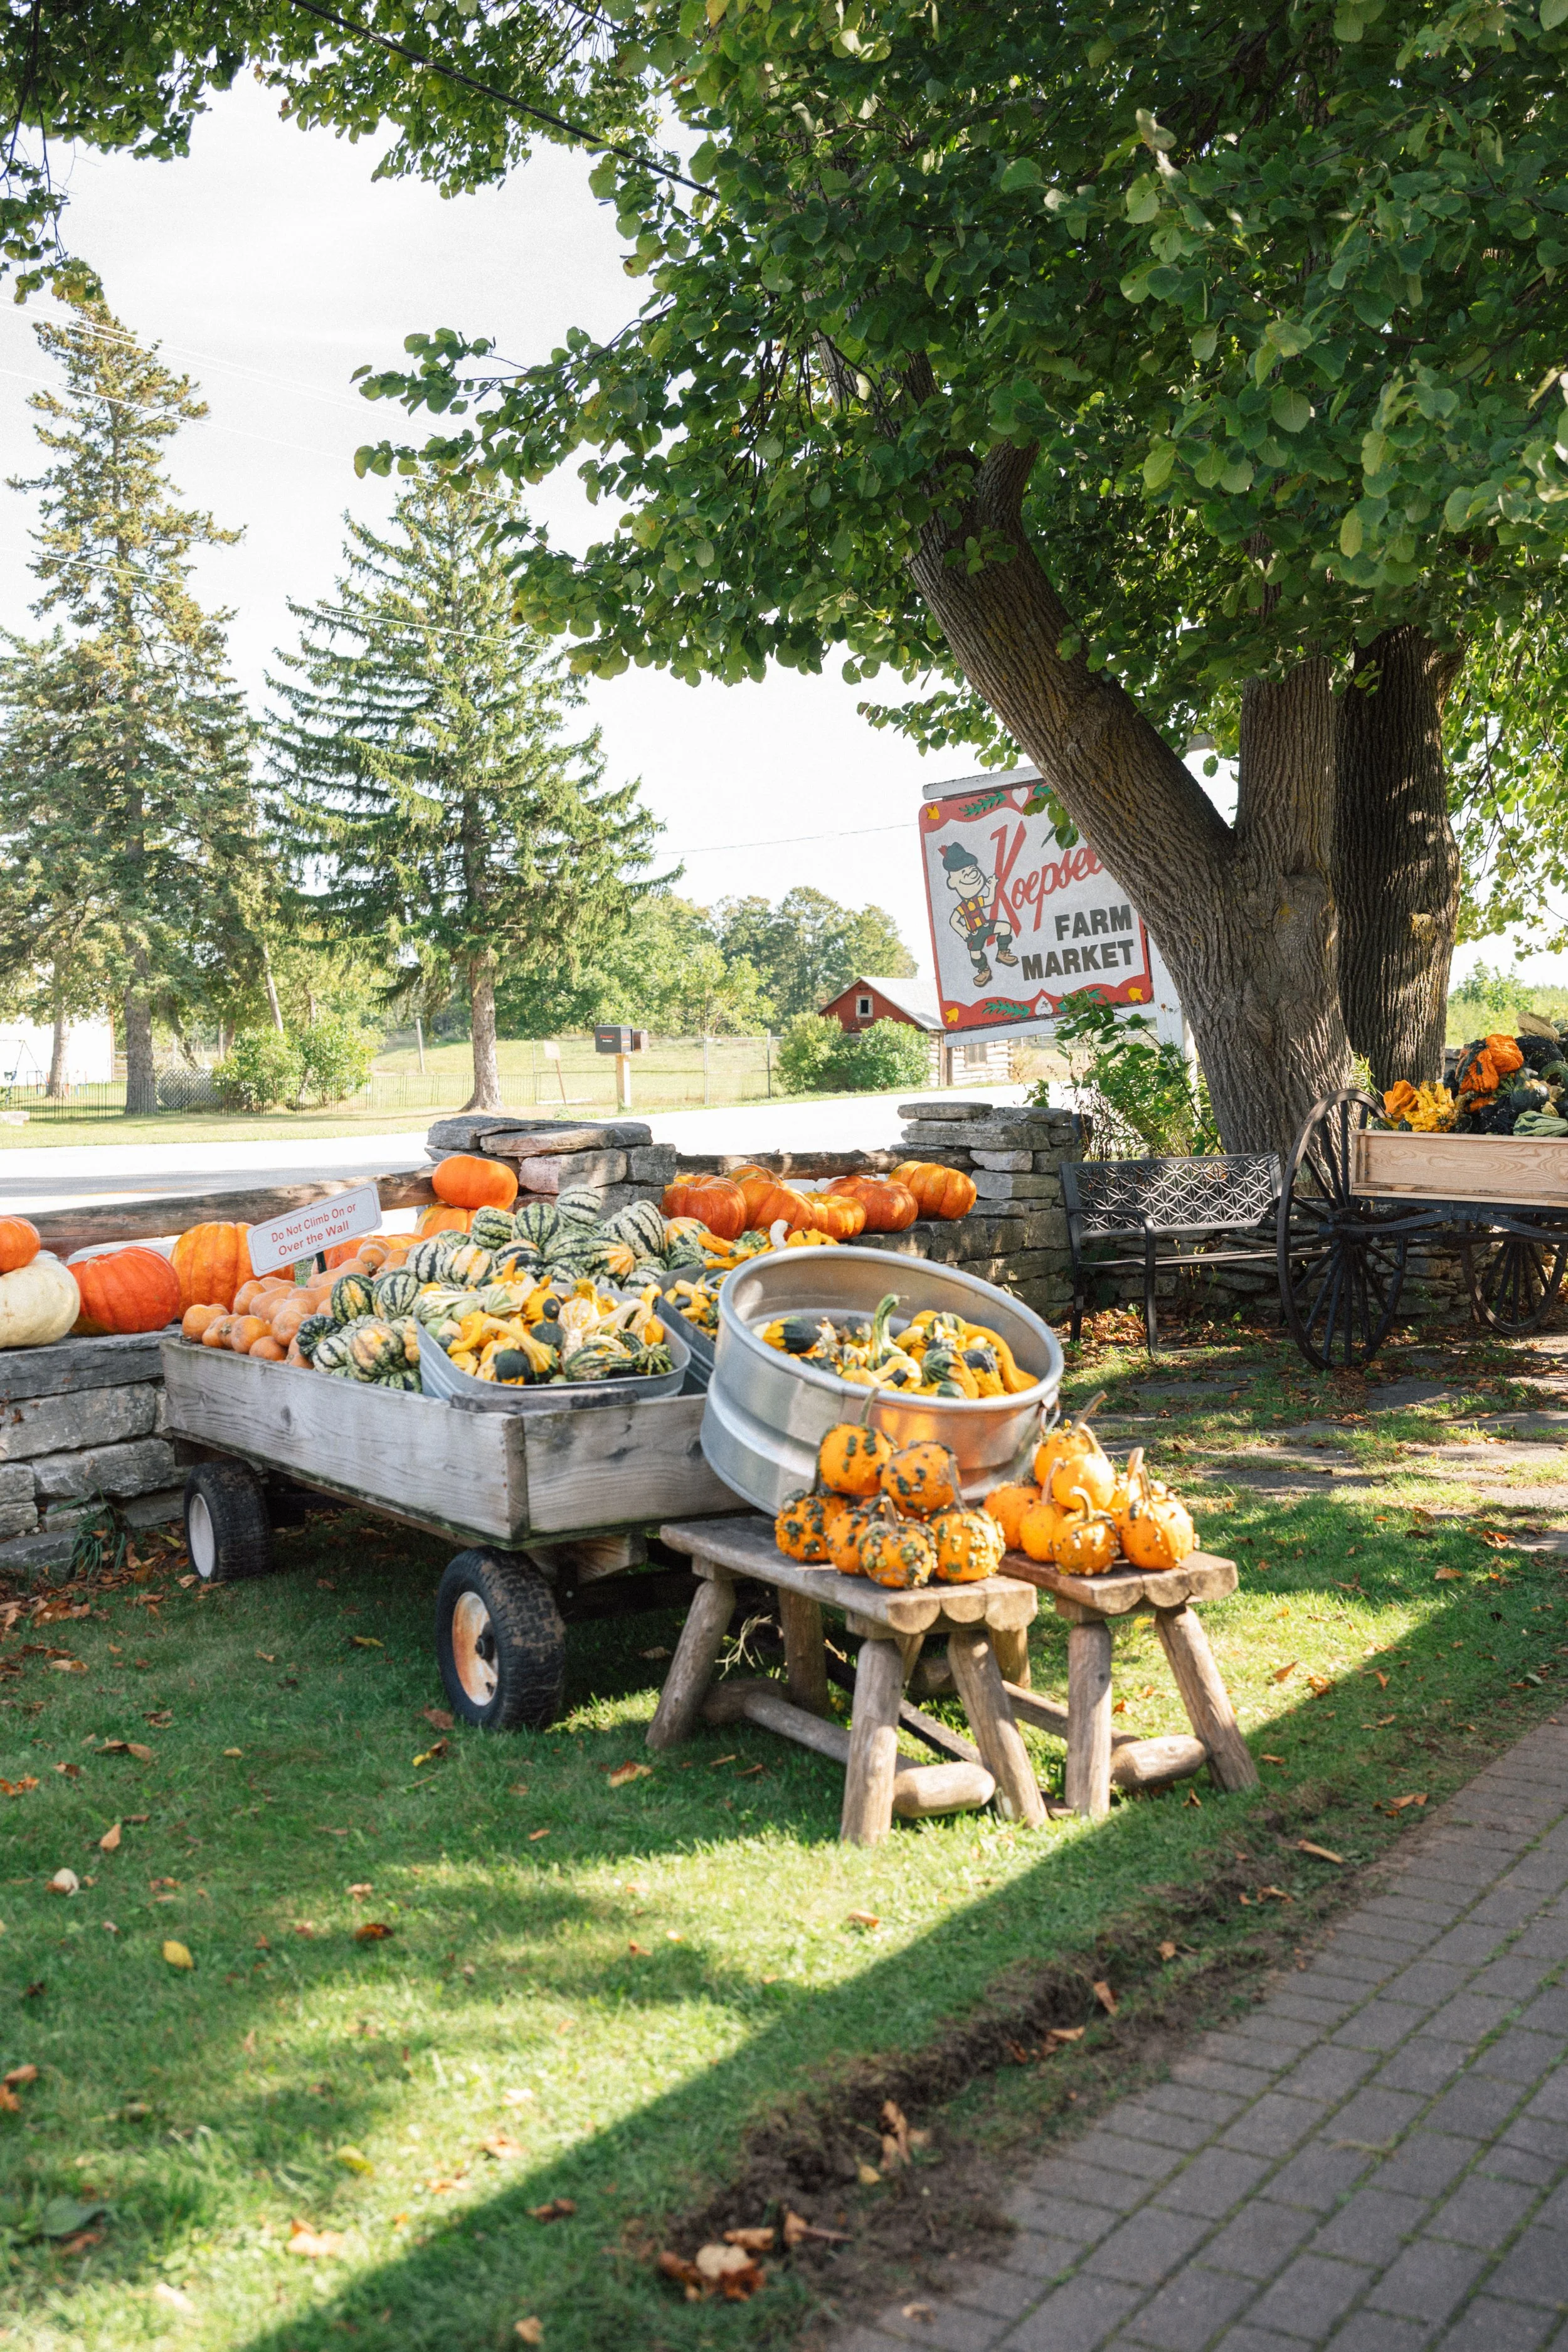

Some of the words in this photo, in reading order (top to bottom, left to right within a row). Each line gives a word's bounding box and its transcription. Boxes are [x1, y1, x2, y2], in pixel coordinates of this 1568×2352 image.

[1054, 904, 1133, 941] FARM
[1021, 939, 1134, 981] MARKET
[272, 1232, 284, 1242] Do
[286, 1223, 302, 1237] Not
[304, 1213, 329, 1229] Climb
[332, 1208, 344, 1219] On
[347, 1204, 356, 1213] or
[278, 1239, 304, 1255] Over
[306, 1232, 323, 1245] the
[326, 1220, 349, 1237] Wall
